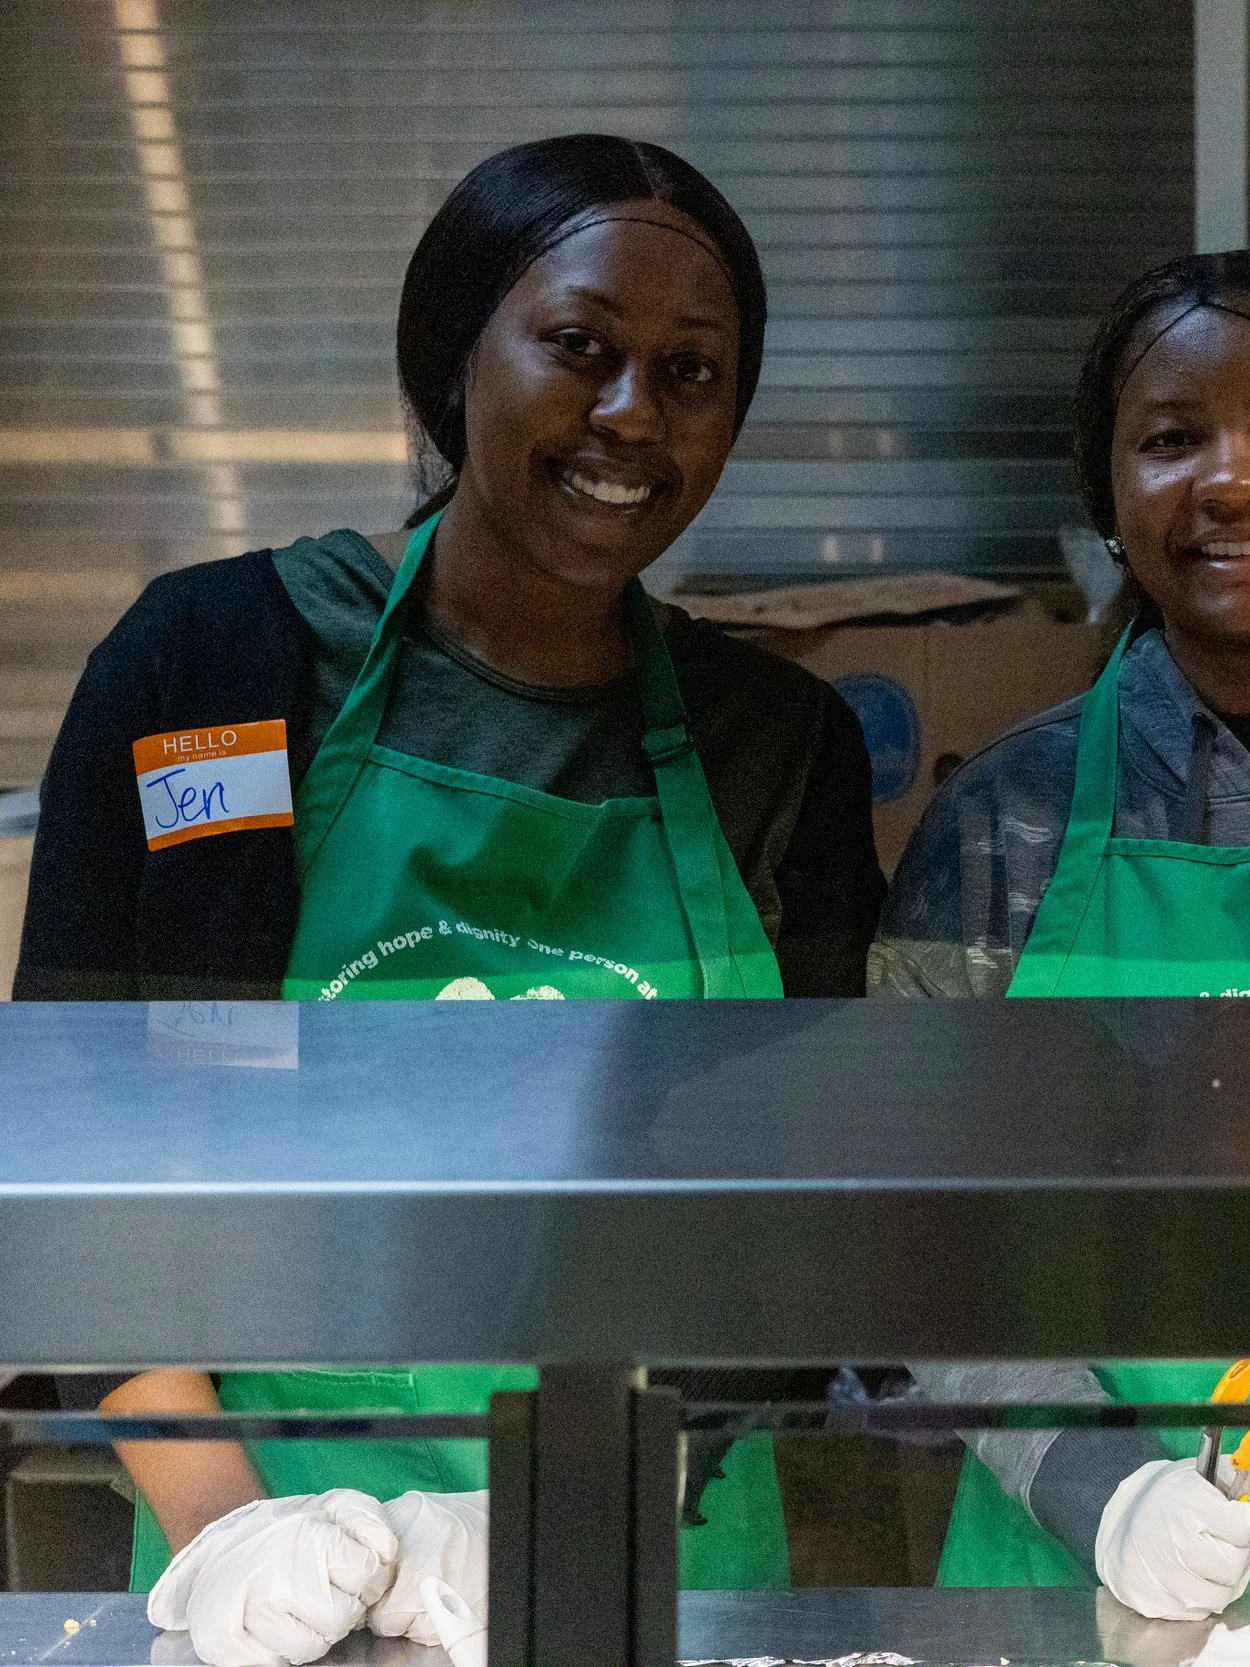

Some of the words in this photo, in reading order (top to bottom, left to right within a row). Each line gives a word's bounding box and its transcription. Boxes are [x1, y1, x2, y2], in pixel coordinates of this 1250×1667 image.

[163, 730, 237, 755] HELLO
[178, 755, 191, 763] my
[192, 751, 217, 760] name
[146, 768, 230, 829] Jen
[318, 950, 379, 1001] toring
[377, 926, 434, 957] hope
[438, 919, 452, 935] &
[455, 921, 521, 948] dignity
[568, 950, 640, 985] person
[637, 980, 658, 1001] at
